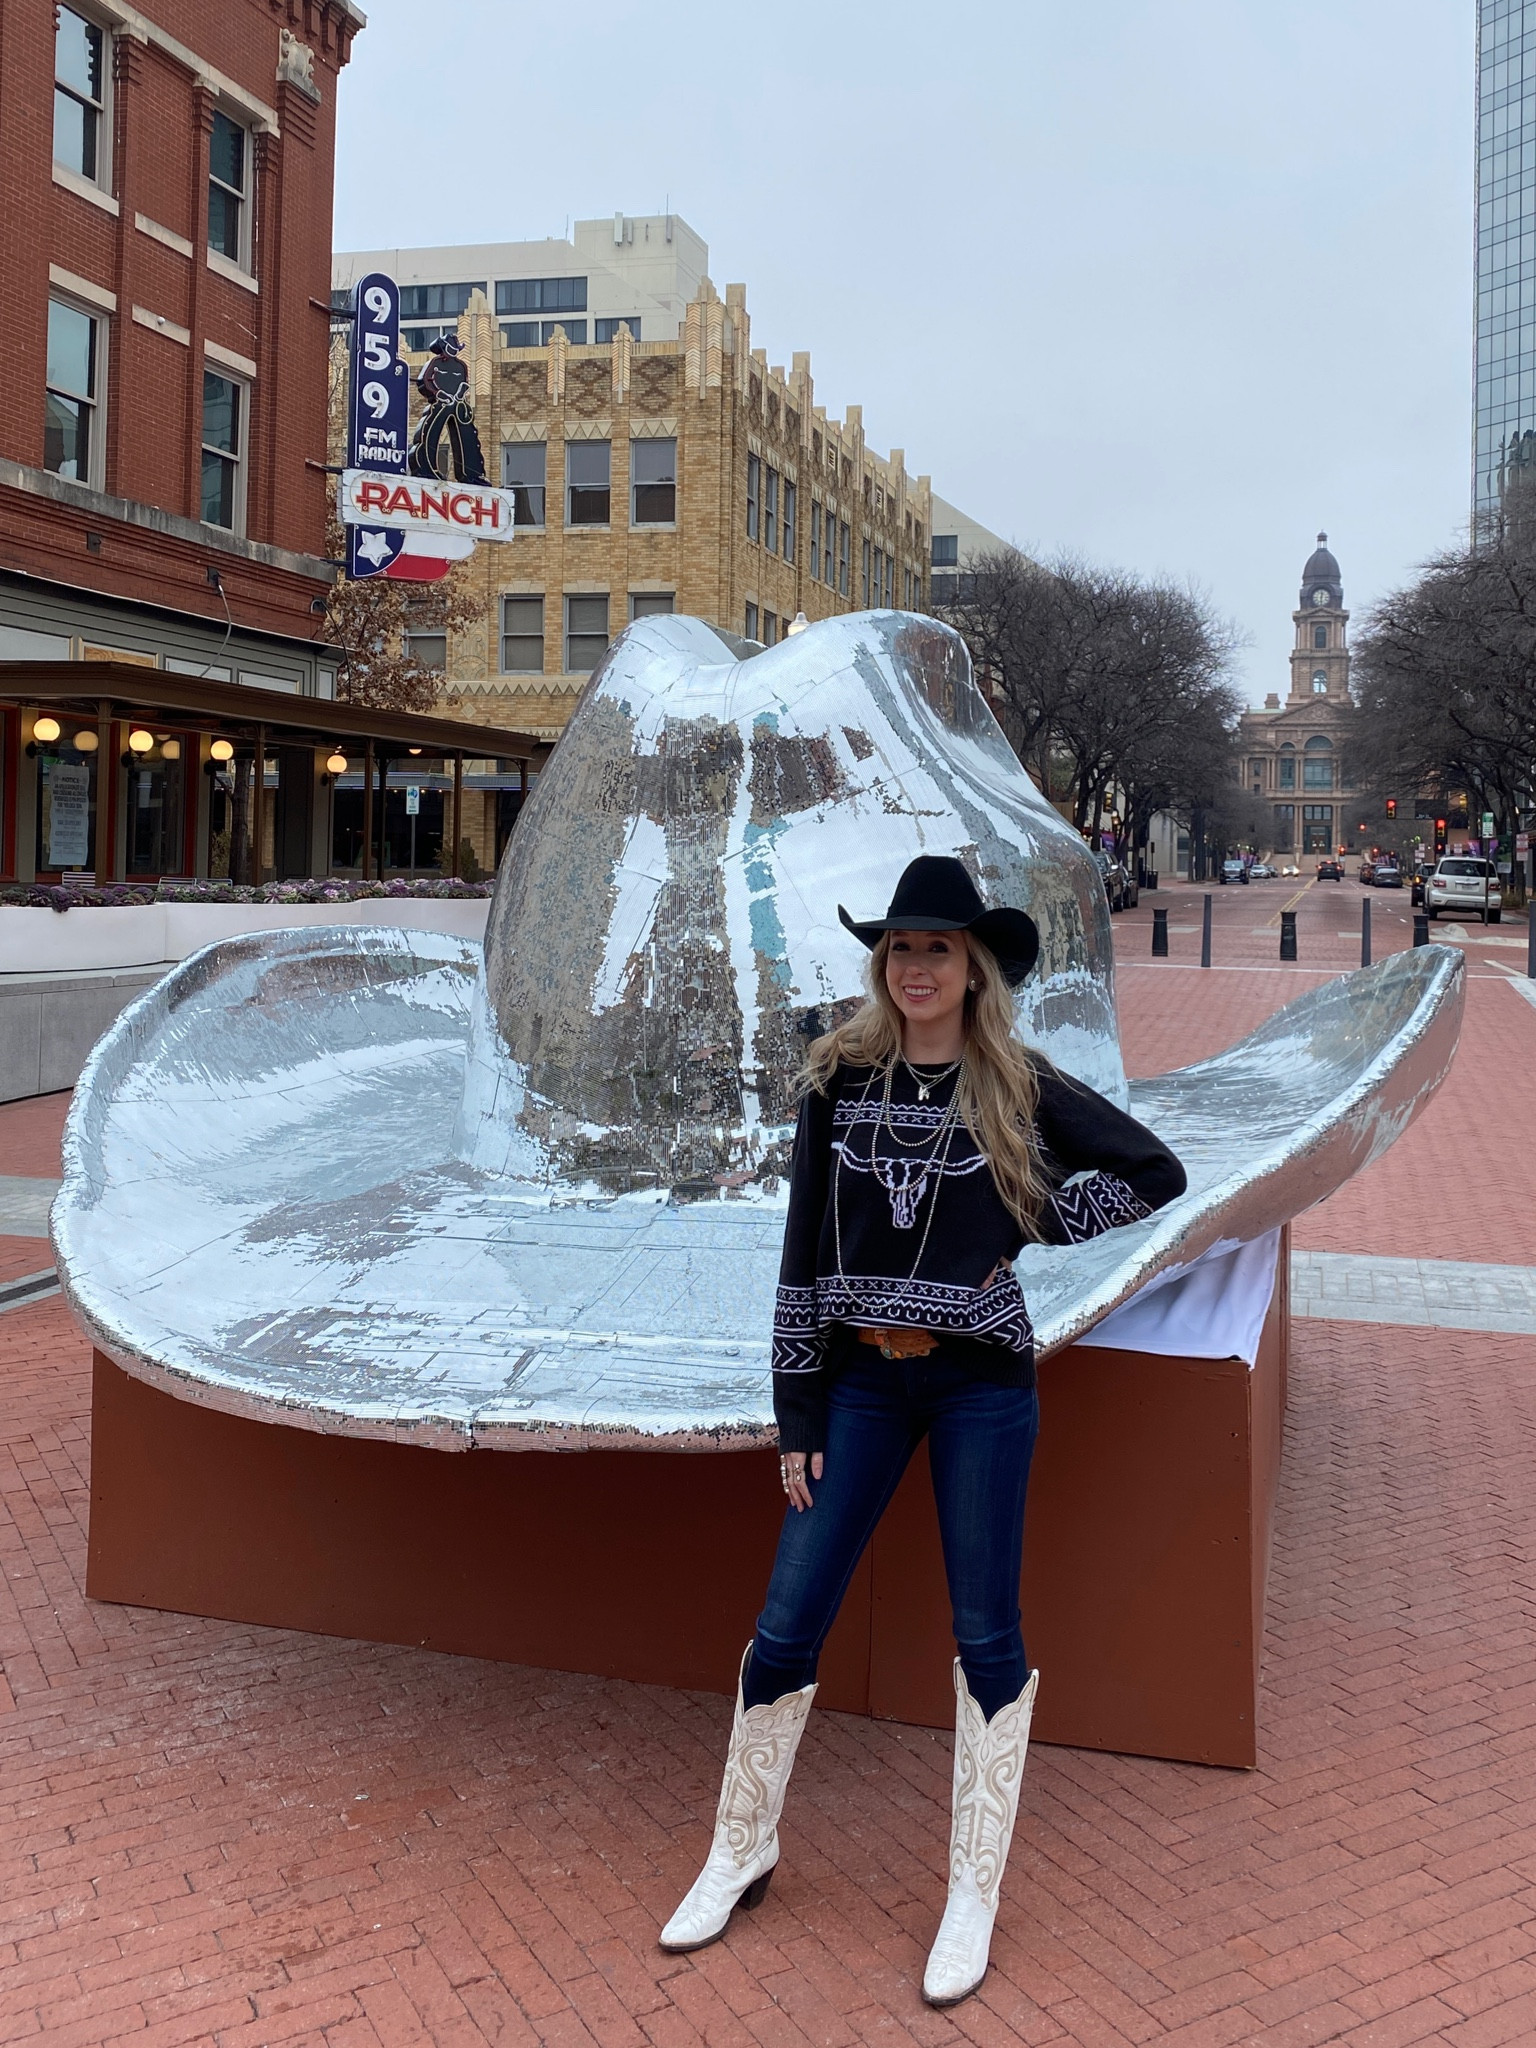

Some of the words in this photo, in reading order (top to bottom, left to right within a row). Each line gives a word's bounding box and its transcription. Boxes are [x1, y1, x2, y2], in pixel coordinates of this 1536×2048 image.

[364, 427, 397, 446] FM
[359, 444, 404, 463] RADIO
[356, 481, 500, 528] RANCH
